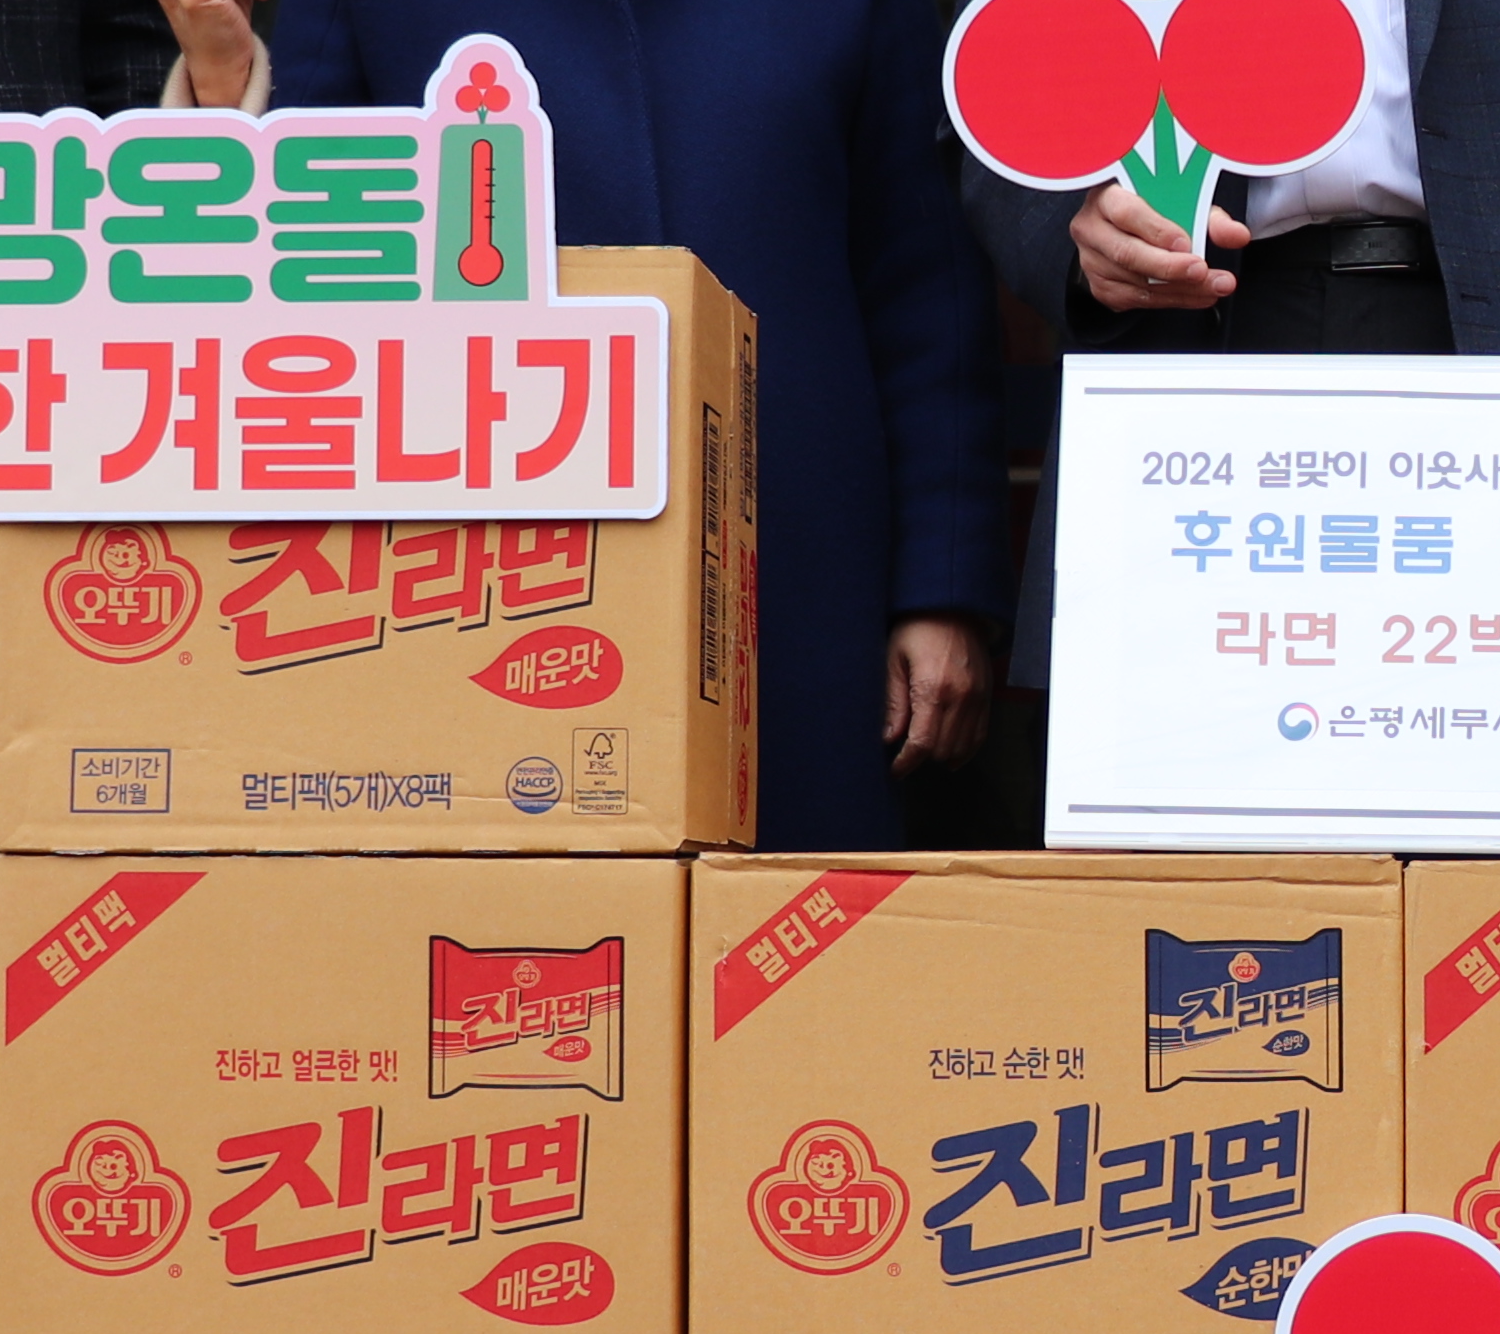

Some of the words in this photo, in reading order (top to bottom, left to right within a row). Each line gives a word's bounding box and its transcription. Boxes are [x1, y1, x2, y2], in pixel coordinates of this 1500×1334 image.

[99, 334, 637, 491] 겨울나기
[1141, 451, 1234, 486] 2024
[1256, 449, 1368, 490] 설맞이
[1171, 509, 1454, 575] 후원물품
[75, 584, 172, 626] 오뚜기
[220, 520, 598, 676] 진라면
[506, 639, 603, 696] 매운맛
[1215, 611, 1338, 668] 라면
[515, 777, 554, 790] HACCP
[928, 1047, 996, 1081] 진하고
[1003, 1046, 1050, 1081] 순한
[208, 1106, 589, 1291] 진라면
[779, 1195, 879, 1236] 오뚜기
[923, 1103, 1310, 1288] 진라면
[496, 1255, 594, 1312] 매운맛
